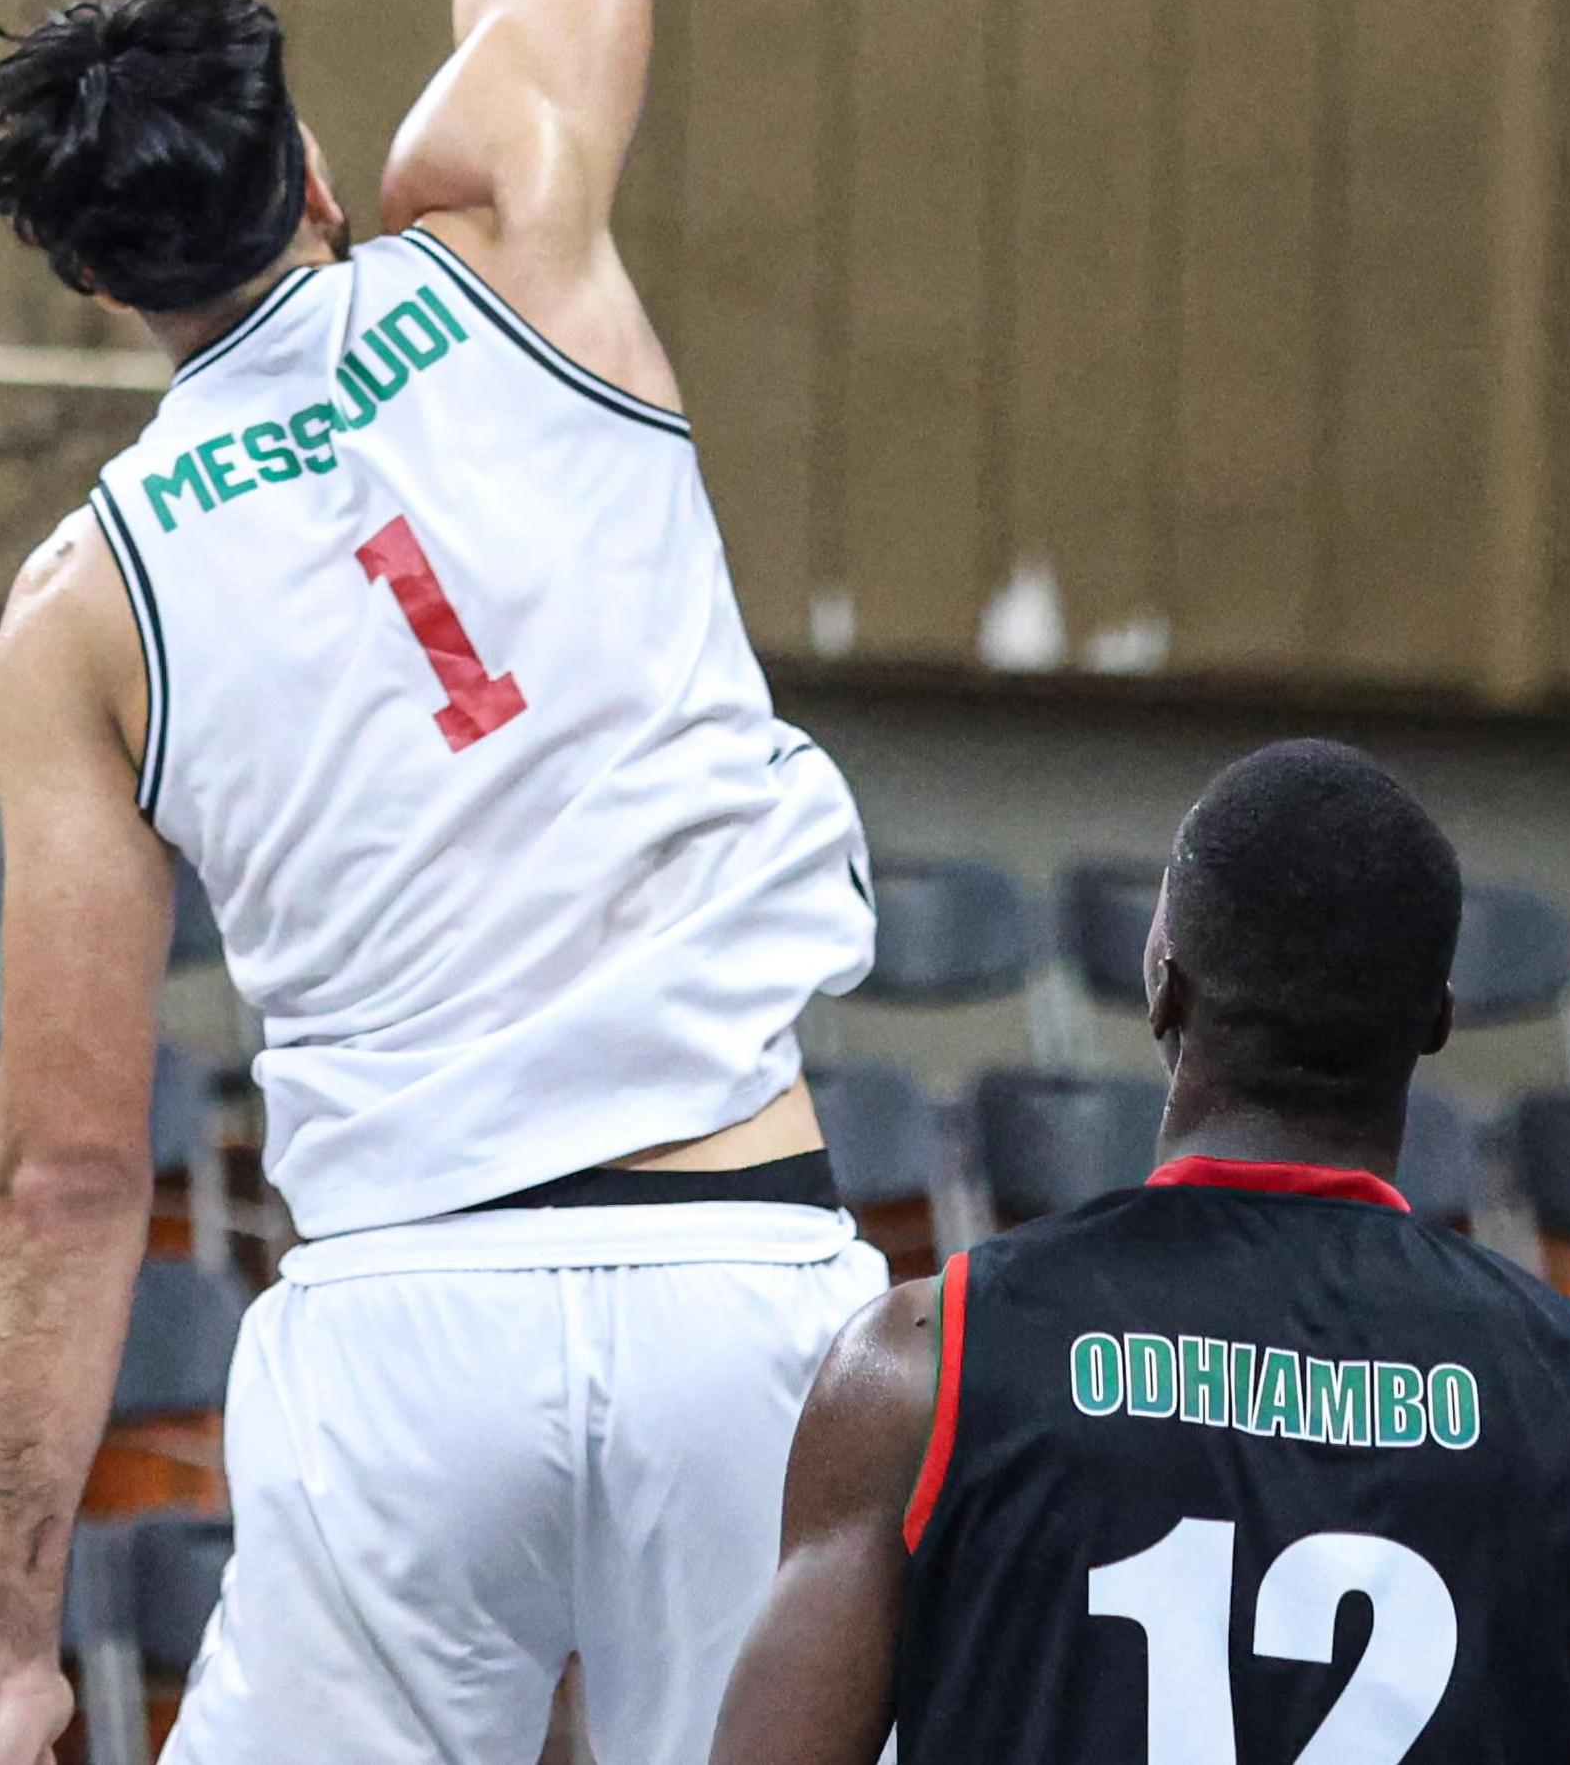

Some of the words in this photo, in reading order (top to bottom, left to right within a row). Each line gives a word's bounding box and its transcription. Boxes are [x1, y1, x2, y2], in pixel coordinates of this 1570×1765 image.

[141, 285, 471, 533] MESSOUDI
[354, 514, 528, 754] 1
[1070, 1332, 1481, 1450] ODHIAMBO
[1088, 1516, 1458, 1765] 12
